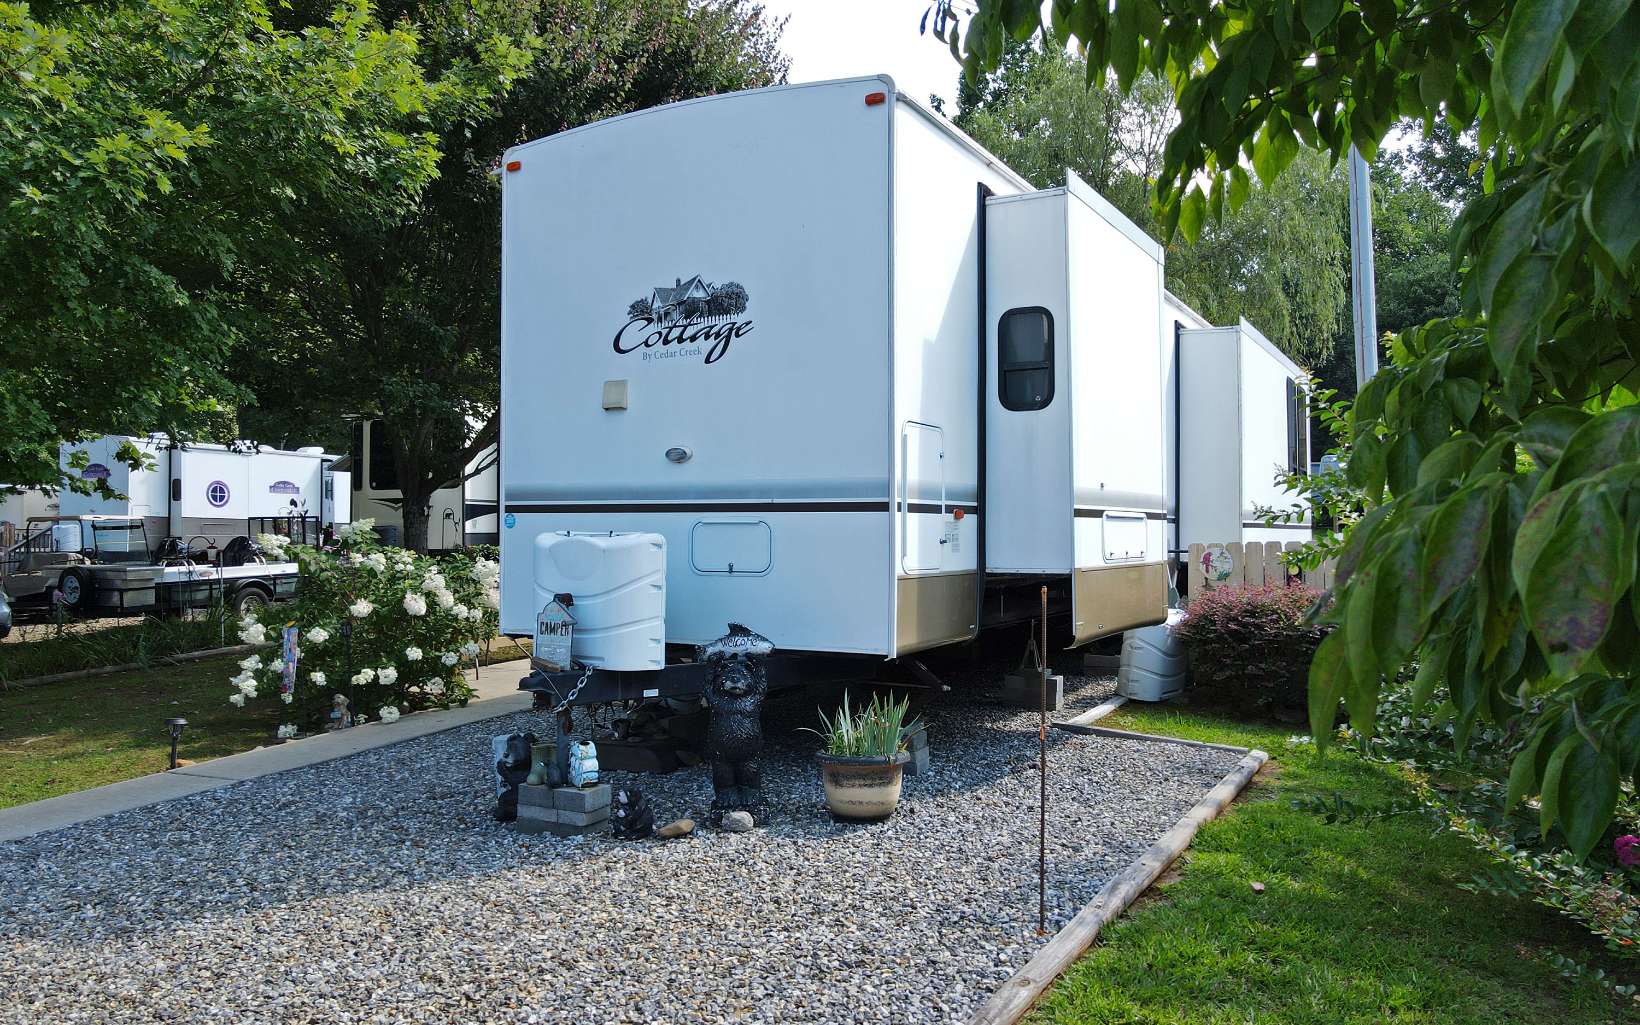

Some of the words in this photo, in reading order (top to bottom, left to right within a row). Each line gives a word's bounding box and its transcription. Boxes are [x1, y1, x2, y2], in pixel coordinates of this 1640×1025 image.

[613, 313, 754, 364] Cottage
[642, 351, 652, 363] By
[655, 349, 677, 360] Cedar
[679, 346, 703, 357] Creek
[539, 620, 570, 637] CAMPER
